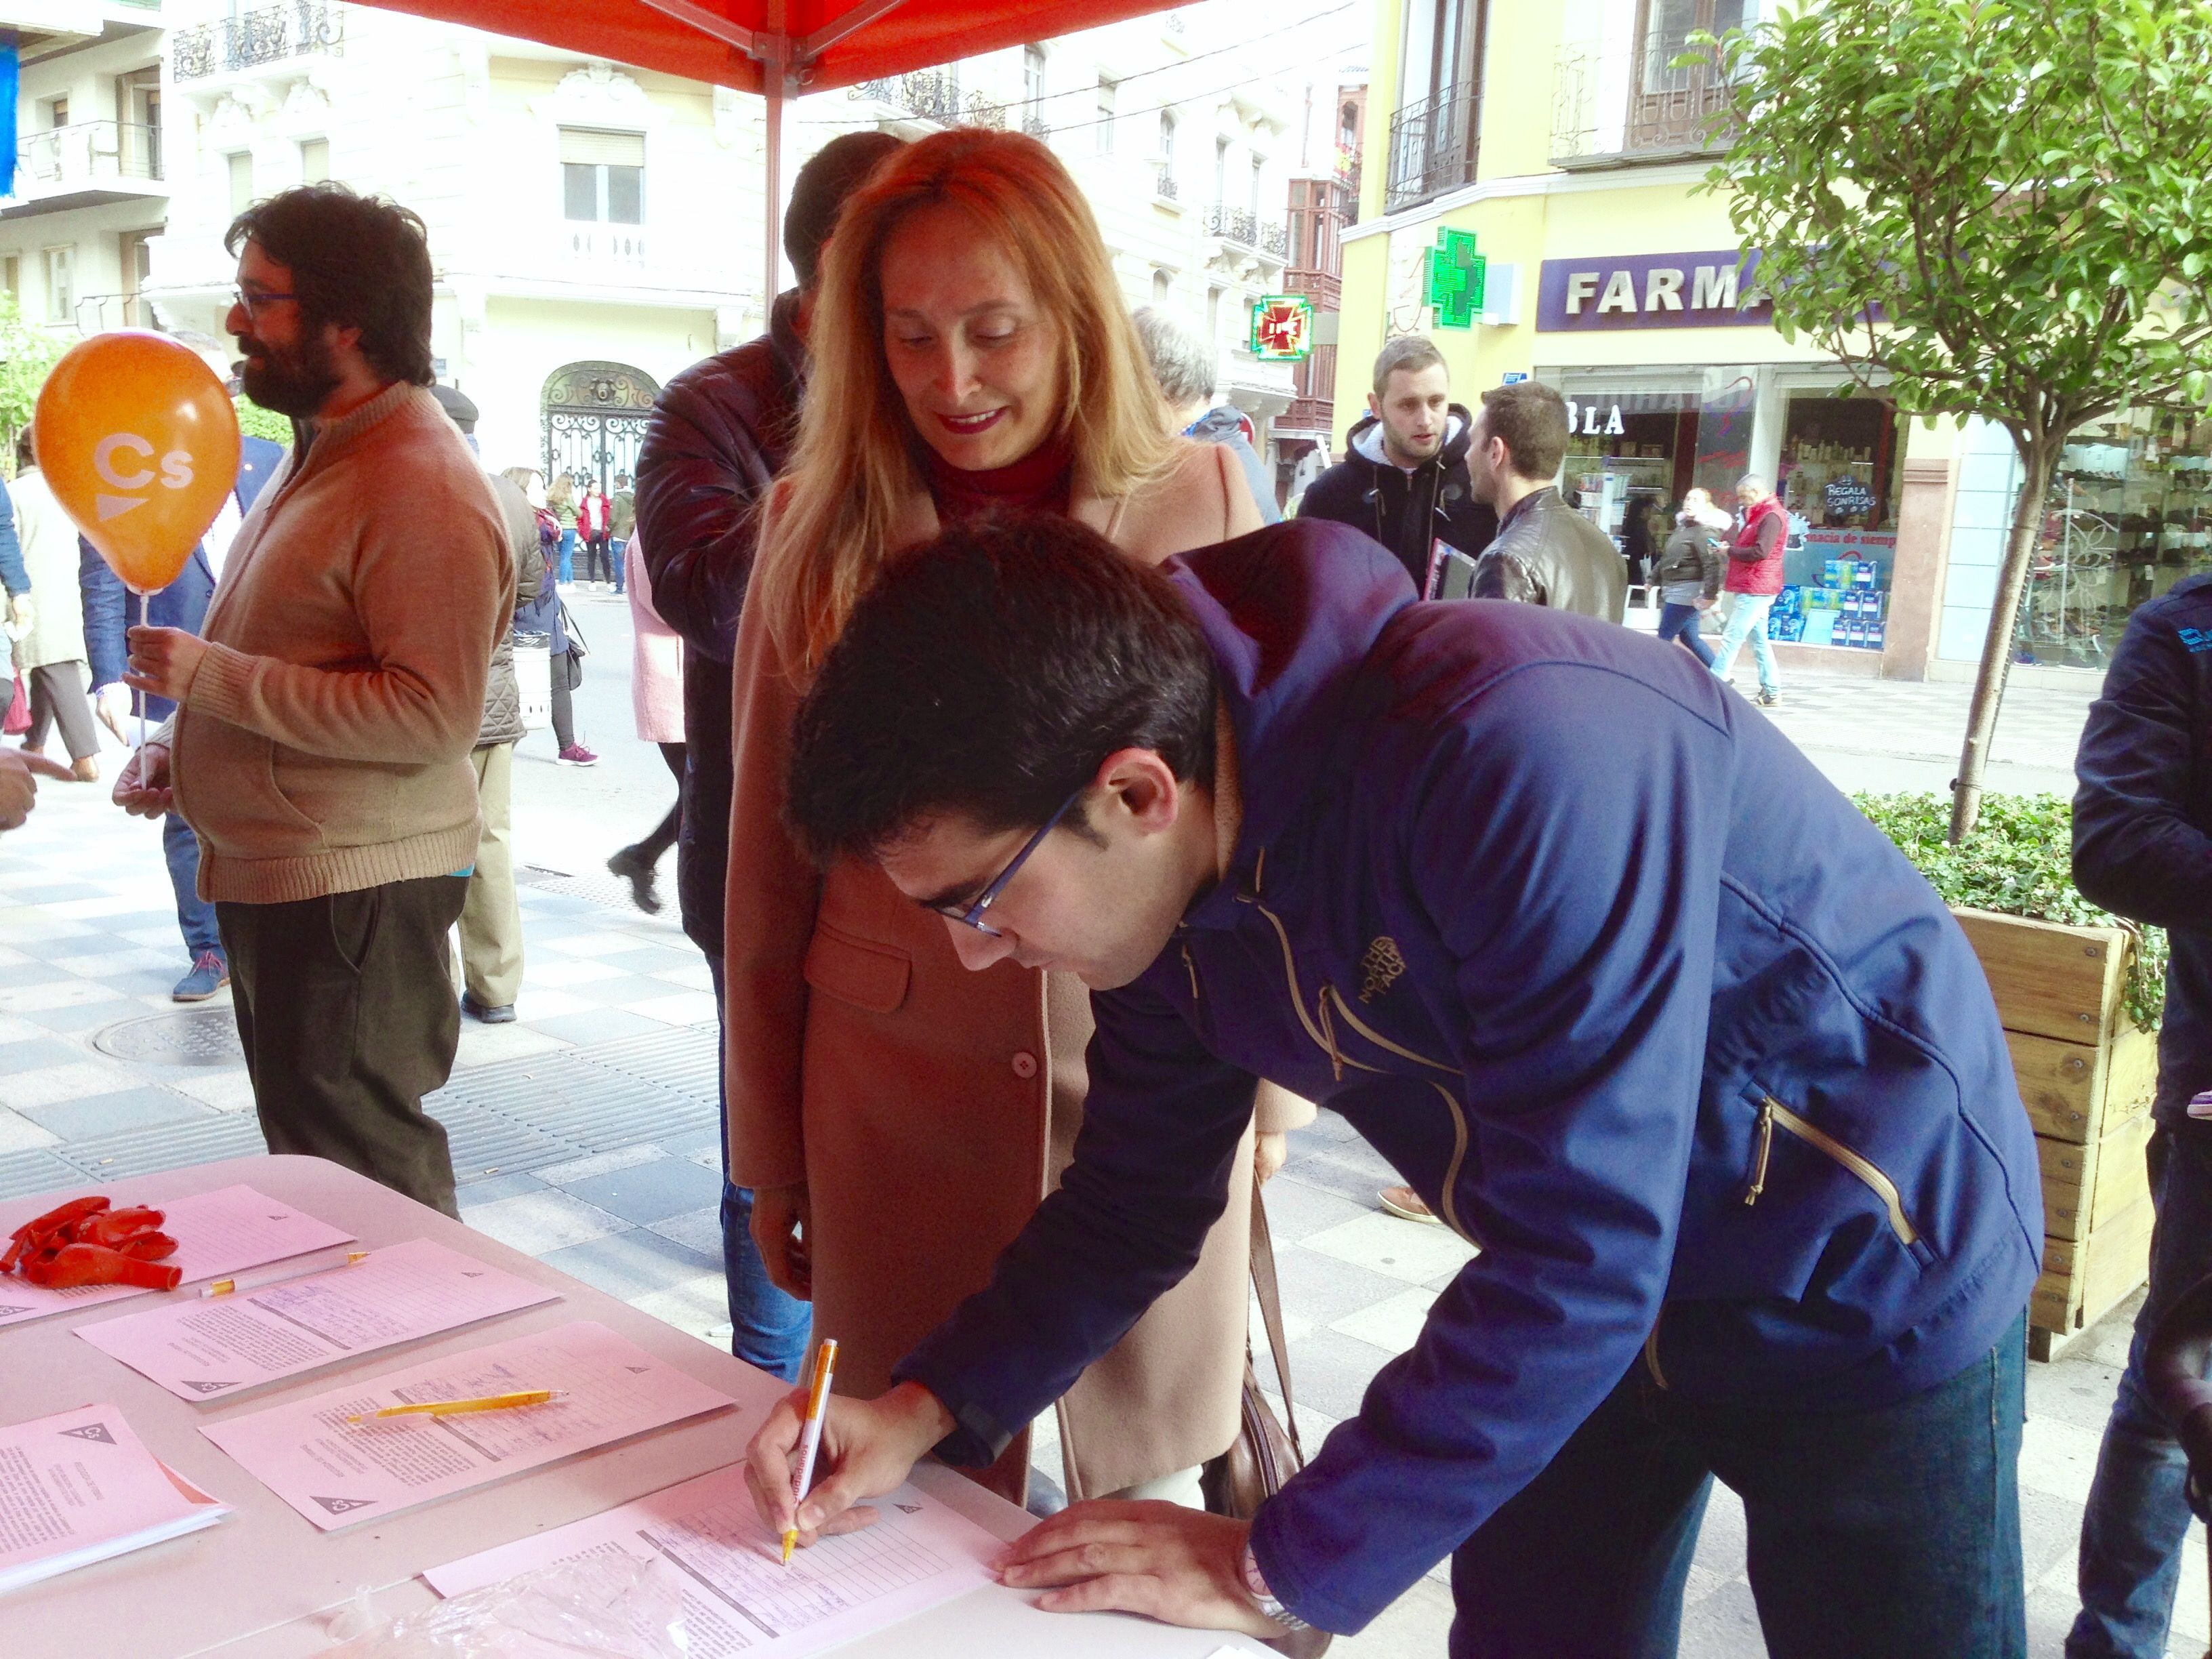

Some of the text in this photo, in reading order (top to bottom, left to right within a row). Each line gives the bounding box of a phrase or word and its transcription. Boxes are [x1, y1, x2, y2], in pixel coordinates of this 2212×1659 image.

[94, 432, 195, 490] Cs
[1824, 484, 1866, 496] REGALA
[1826, 496, 1877, 507] SONRISAS
[1861, 536, 1897, 548] siemp
